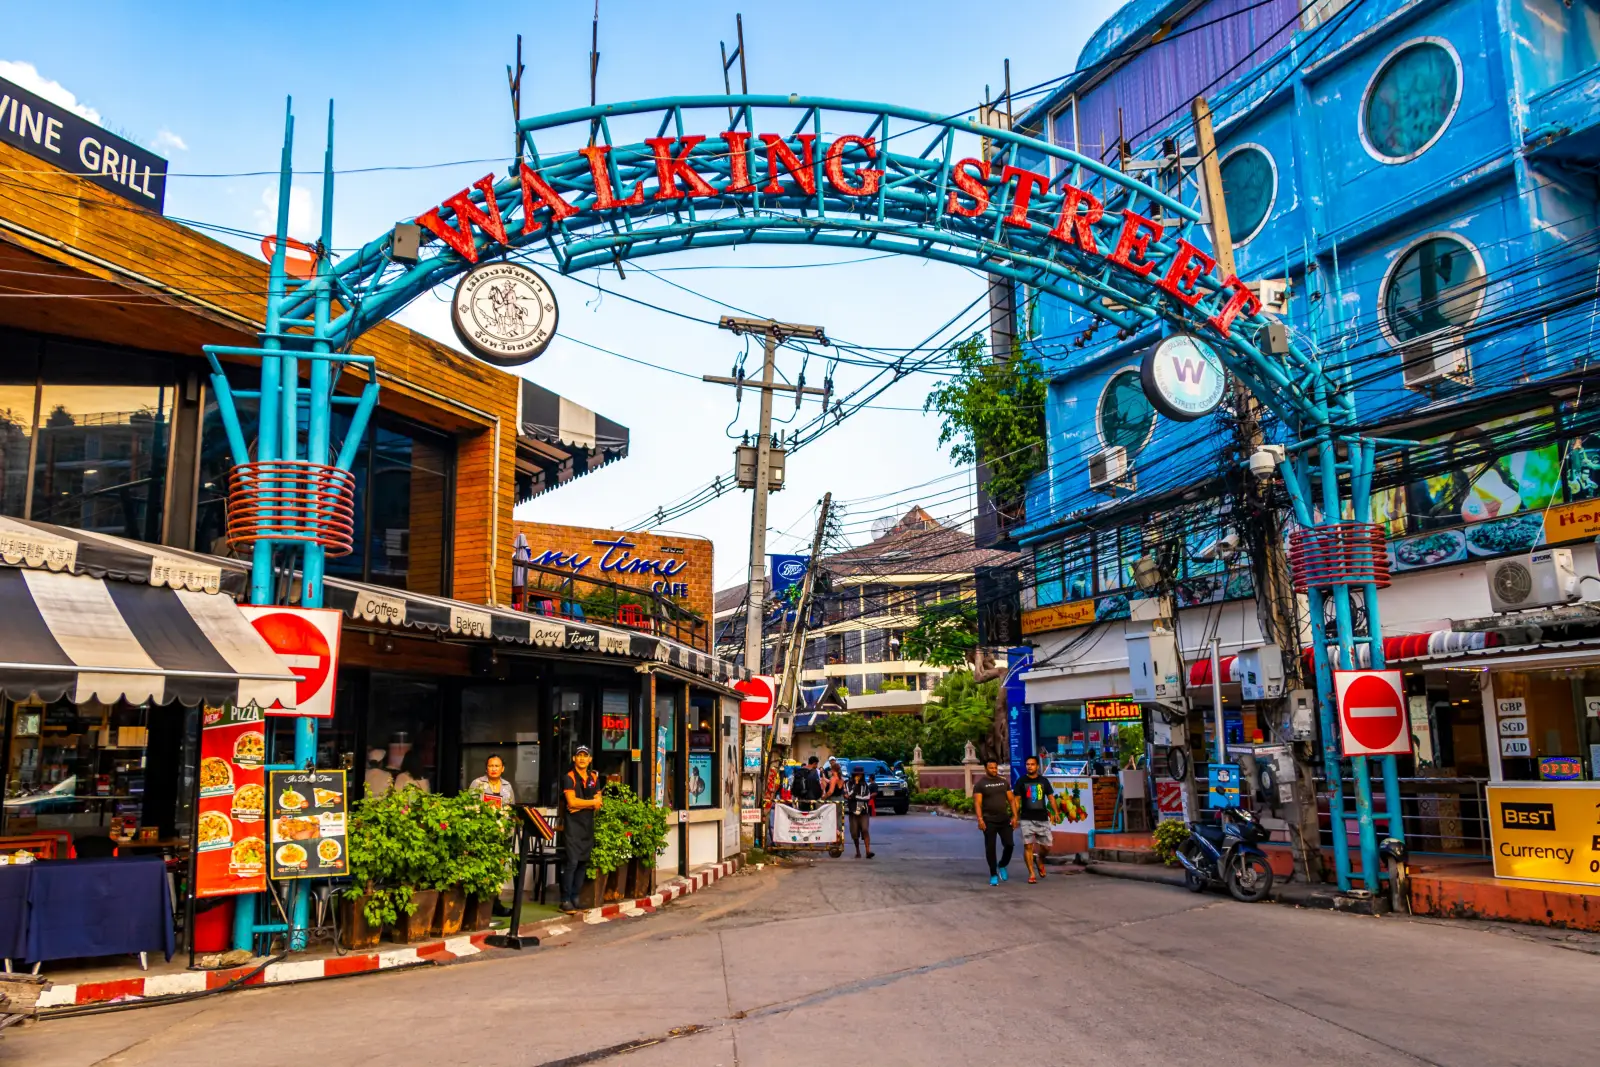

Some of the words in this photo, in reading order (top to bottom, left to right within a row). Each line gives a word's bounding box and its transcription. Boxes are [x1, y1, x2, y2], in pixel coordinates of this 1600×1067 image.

[79, 136, 156, 199] GRILL
[413, 130, 885, 264] WALKING
[946, 156, 1263, 339] STREET
[465, 265, 543, 293] เมืองพัทยา
[652, 580, 689, 598] CAFE
[366, 600, 399, 618] Coffee
[1022, 614, 1054, 627] Happy
[1058, 607, 1089, 620] Singh
[456, 616, 485, 636] Bakery
[535, 629, 561, 643] any
[568, 630, 595, 646] time
[607, 637, 623, 649] Wine
[231, 704, 260, 720] PIZZA
[1088, 702, 1139, 717] Indian
[1500, 702, 1522, 712] GBP
[1502, 722, 1524, 732] SGD
[1505, 742, 1527, 752] AUD
[1540, 763, 1580, 775] OPEN
[1504, 809, 1552, 825] BEST
[1500, 842, 1574, 864] Currency
